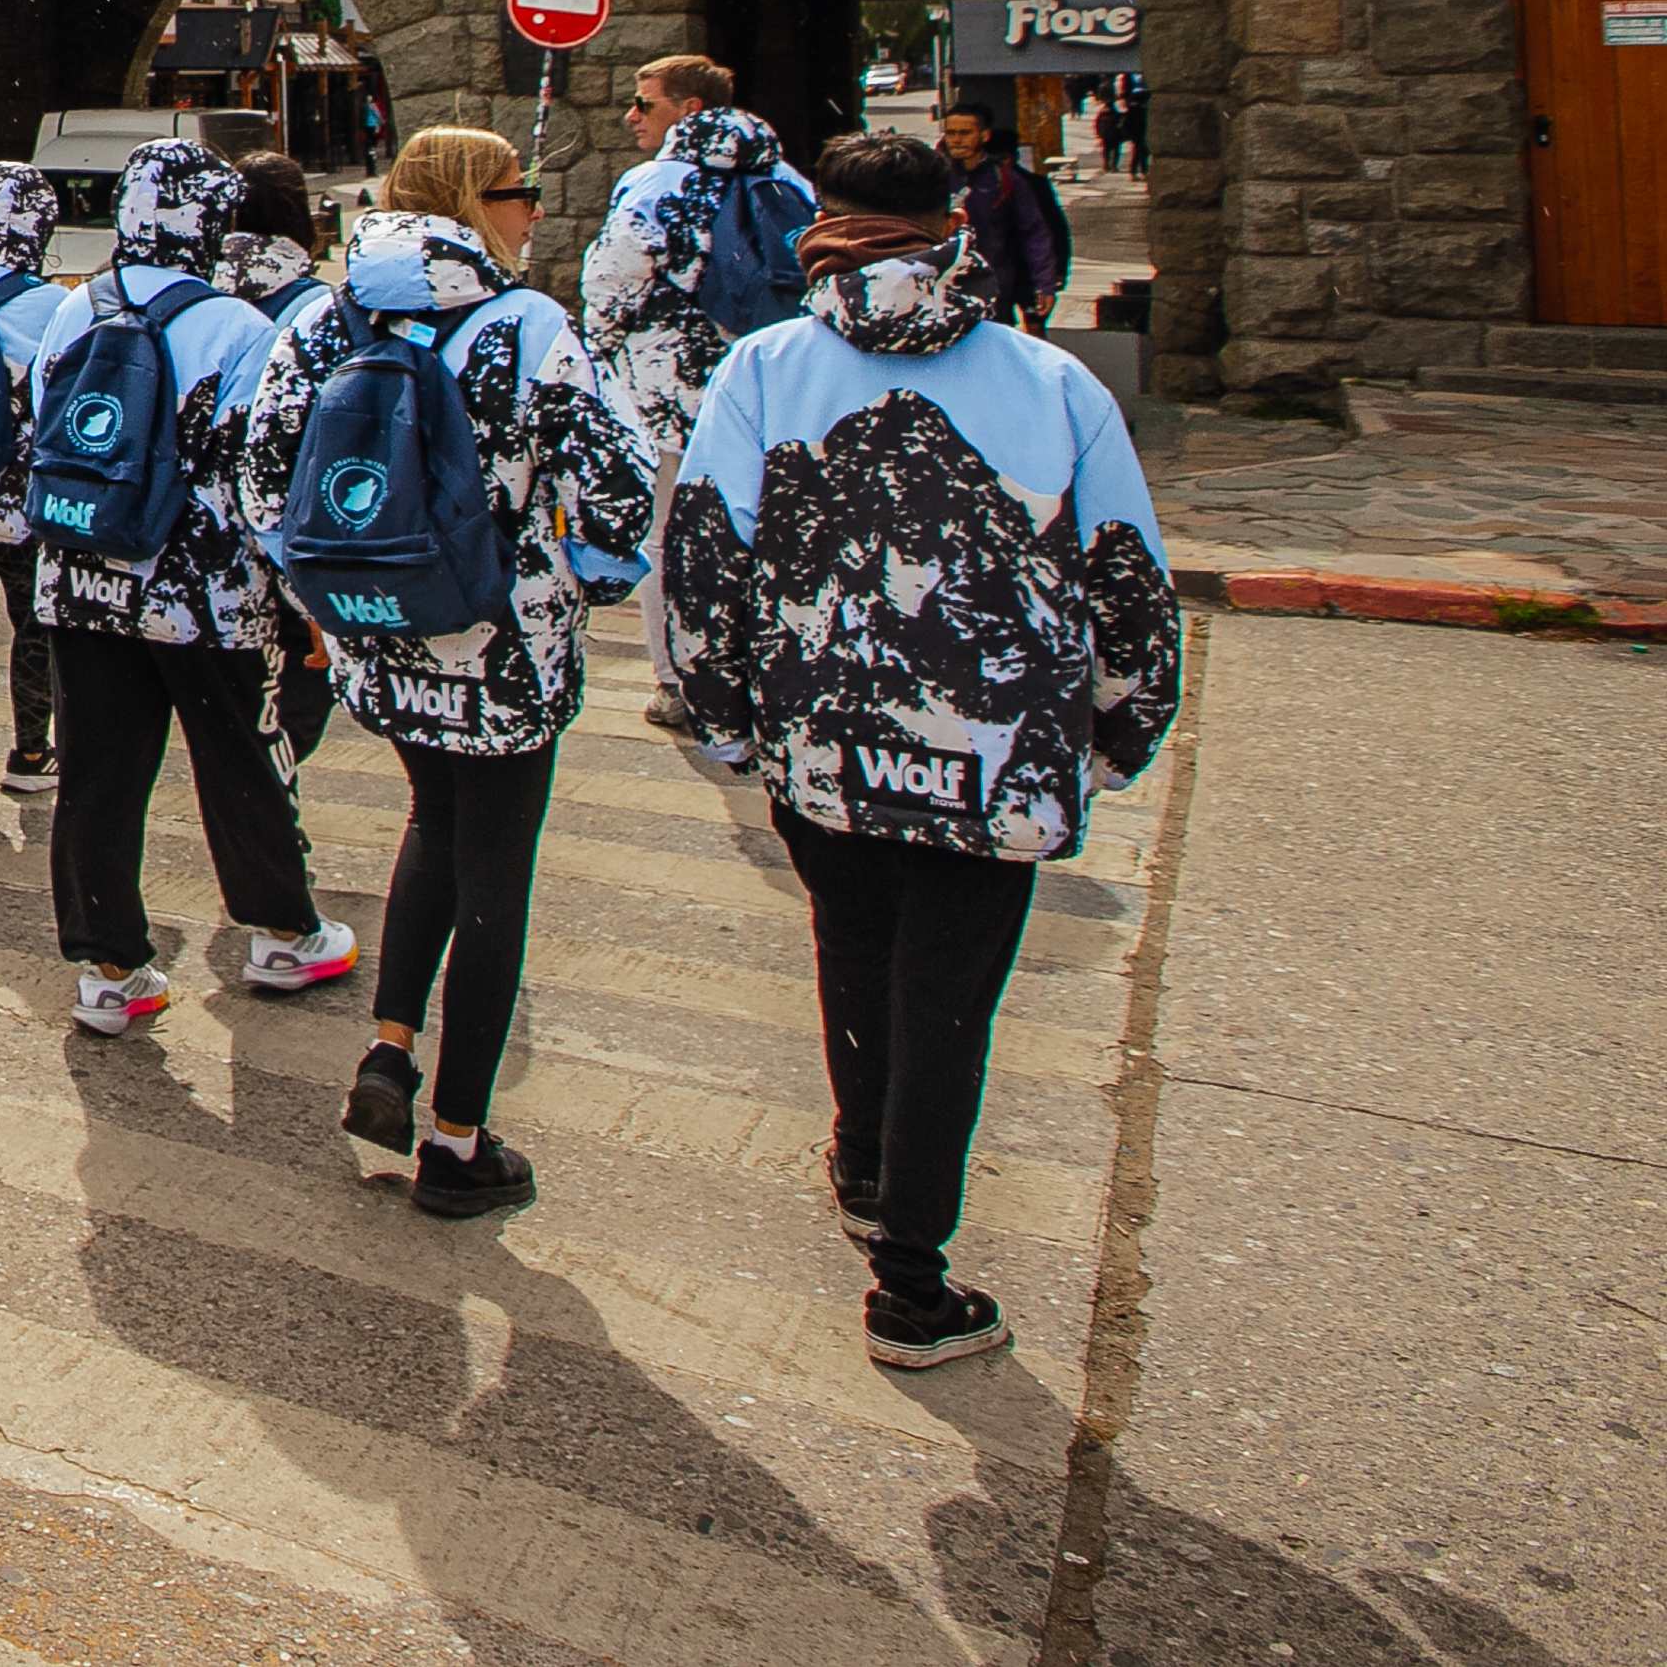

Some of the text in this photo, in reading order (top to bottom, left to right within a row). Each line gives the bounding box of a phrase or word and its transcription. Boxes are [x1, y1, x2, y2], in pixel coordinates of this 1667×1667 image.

[44, 493, 96, 529] Wolf
[69, 566, 132, 607] Wolf
[327, 593, 404, 623] Wolf
[388, 673, 467, 720] Wolf
[855, 745, 965, 800] Wolf
[929, 796, 966, 810] travel
